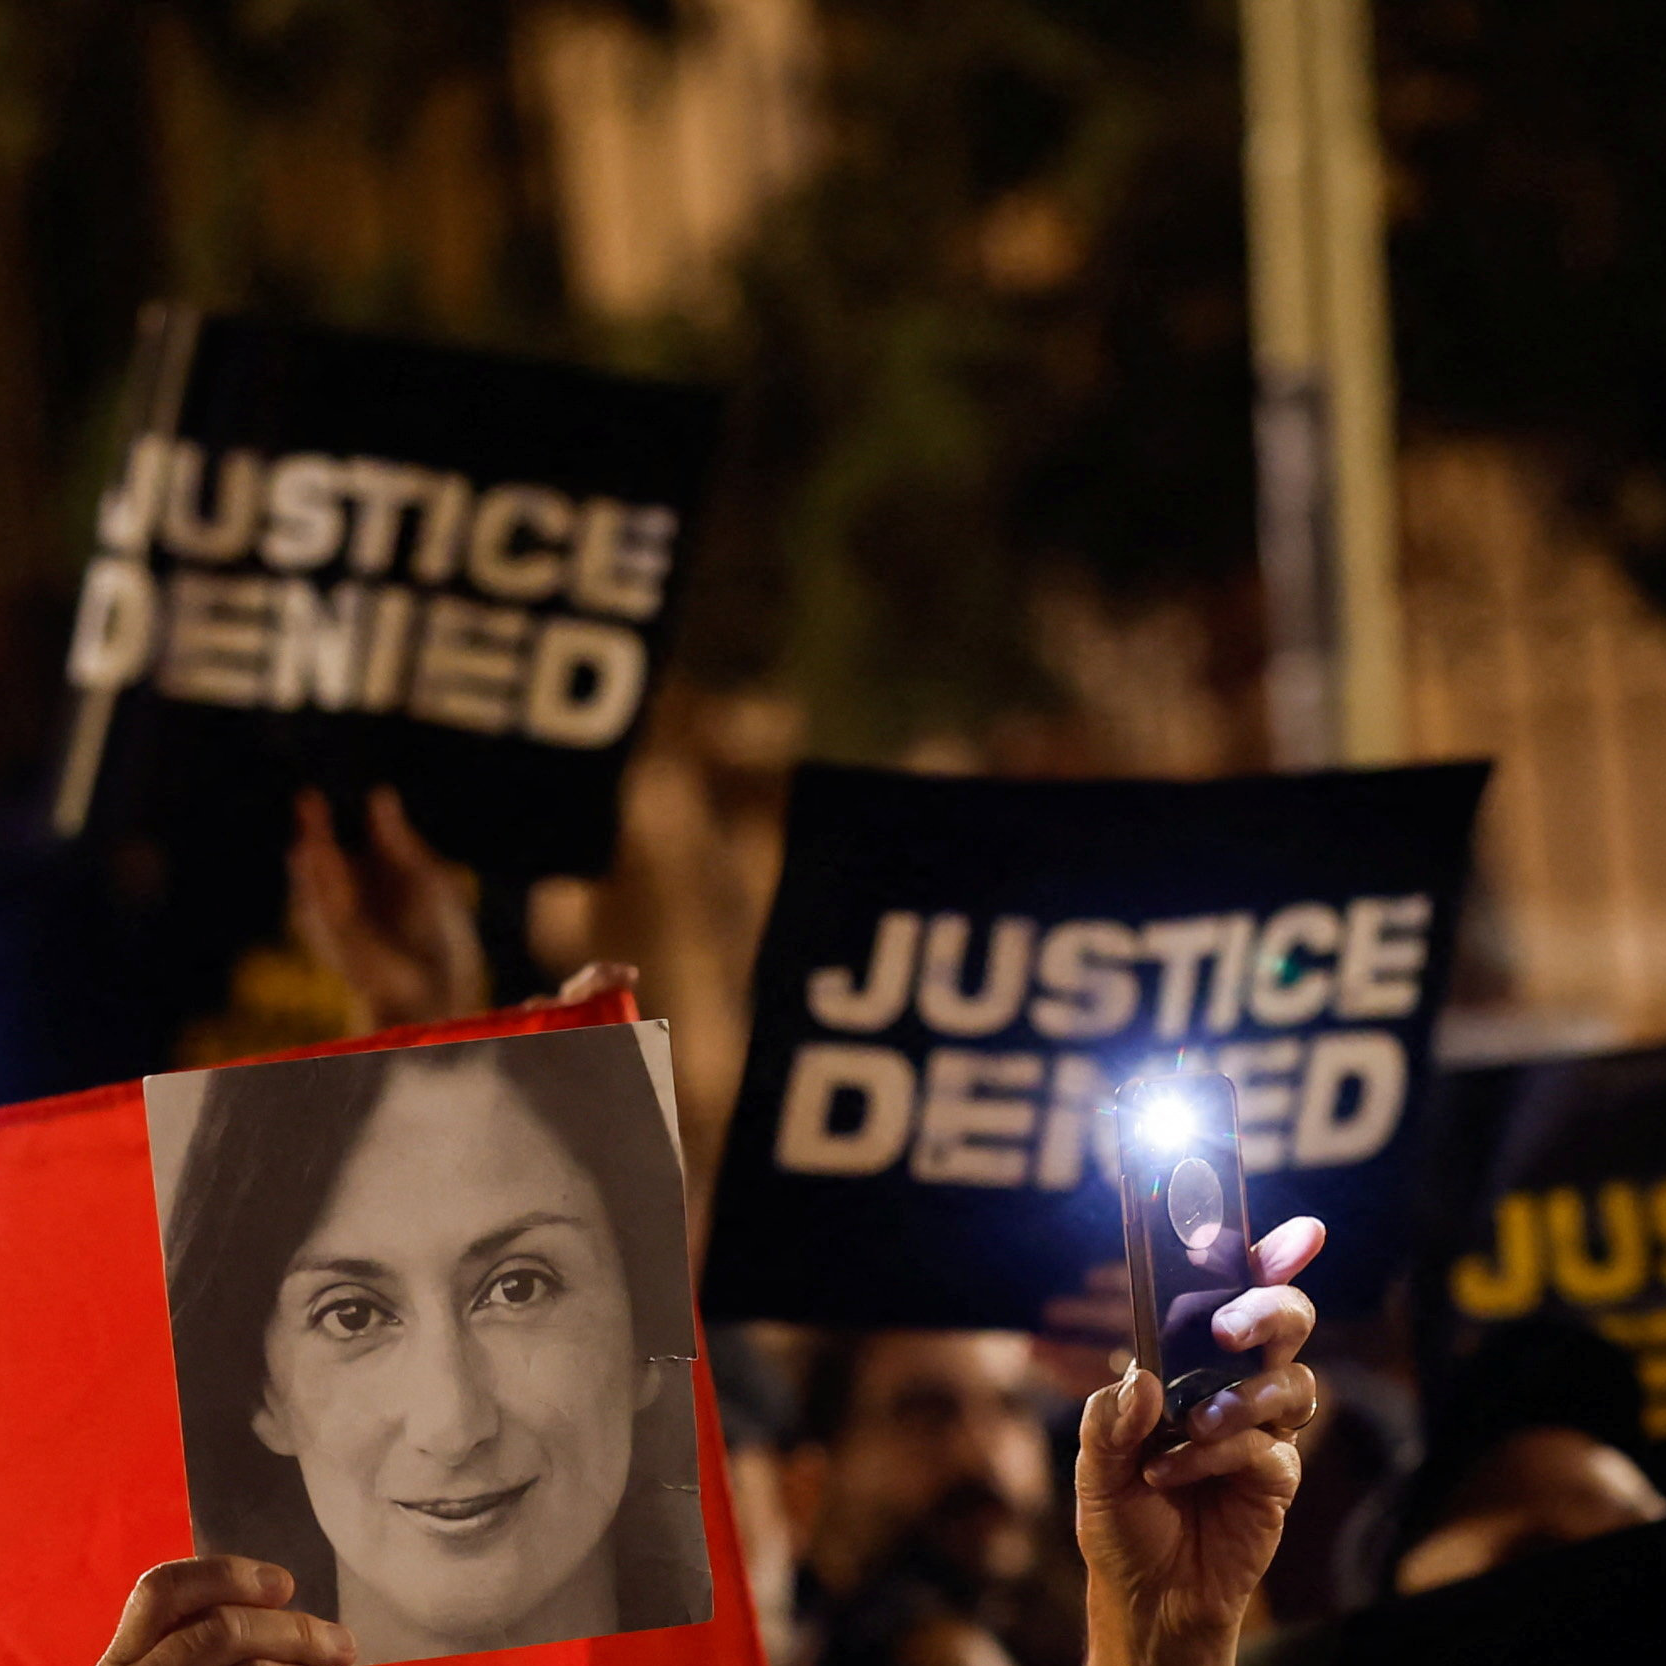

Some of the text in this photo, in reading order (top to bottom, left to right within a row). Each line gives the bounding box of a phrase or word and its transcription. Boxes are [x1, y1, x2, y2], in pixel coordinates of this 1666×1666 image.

[96, 436, 679, 620] JUSTICE
[65, 552, 647, 749] DENIED
[805, 892, 1434, 1042] JUSTICE
[773, 1029, 1410, 1194] DENED
